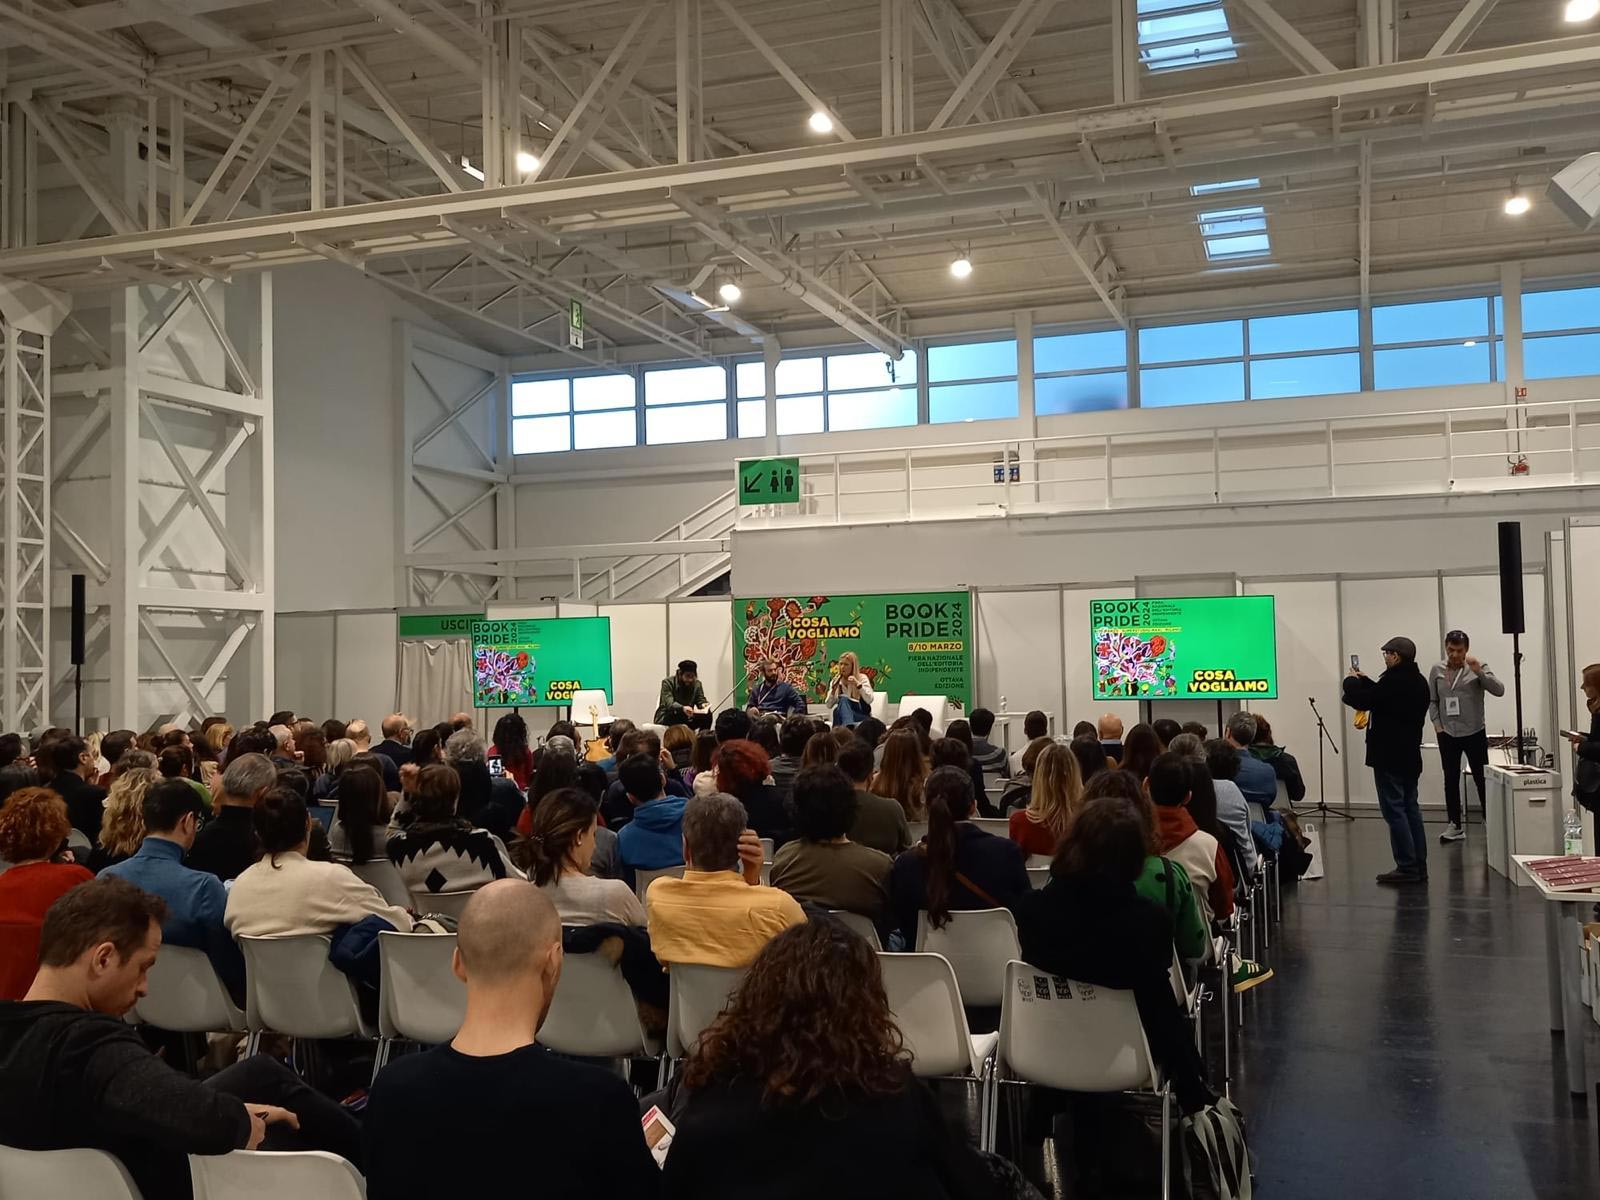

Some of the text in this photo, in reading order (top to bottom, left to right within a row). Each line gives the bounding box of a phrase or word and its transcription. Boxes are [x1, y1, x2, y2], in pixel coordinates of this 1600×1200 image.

[886, 602, 949, 620] BOOK
[1093, 601, 1140, 614] BOOK
[1142, 601, 1151, 626] 2024
[440, 618, 477, 631] USCI
[792, 616, 829, 628] COSA
[952, 601, 963, 637] 2024
[1093, 615, 1141, 627] PRIDE
[473, 622, 509, 633] BOOK
[510, 622, 518, 644] 2024
[787, 627, 860, 639] VOGLIAMO
[886, 621, 949, 638] PRIDE
[474, 633, 509, 644] PRIDE
[908, 642, 962, 652] 8/10 MARZO
[1194, 670, 1235, 681] COSA
[550, 681, 581, 690] COSA
[1189, 680, 1268, 692] VOGLIAMO
[1523, 777, 1547, 786] plastica
